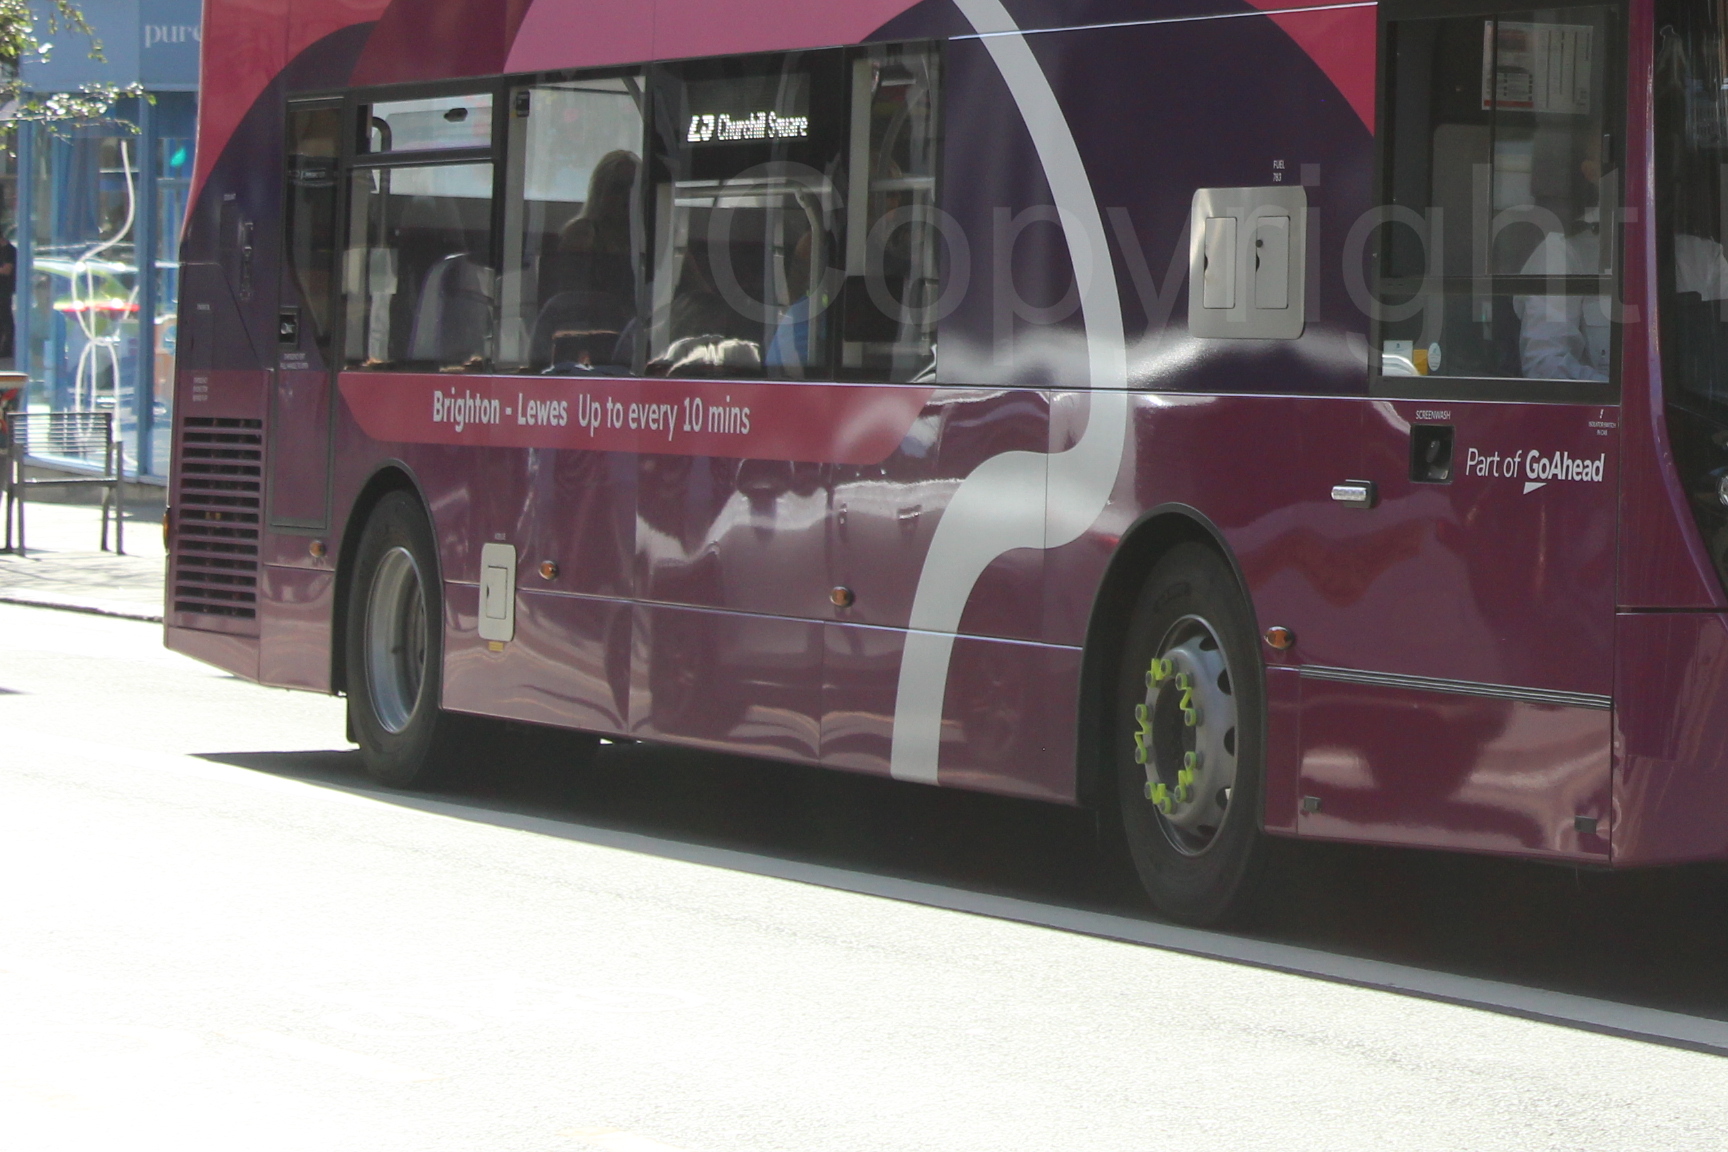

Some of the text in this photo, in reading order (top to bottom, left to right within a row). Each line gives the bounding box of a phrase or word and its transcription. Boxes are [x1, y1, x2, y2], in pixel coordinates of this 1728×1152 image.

[433, 387, 500, 433] Brighton
[517, 393, 568, 427] Lewes
[578, 394, 601, 437] Up
[606, 396, 624, 429] to
[628, 402, 678, 441] every
[683, 397, 703, 433] 10
[708, 395, 750, 434] mins
[1466, 447, 1606, 483] Part of GoAhead
